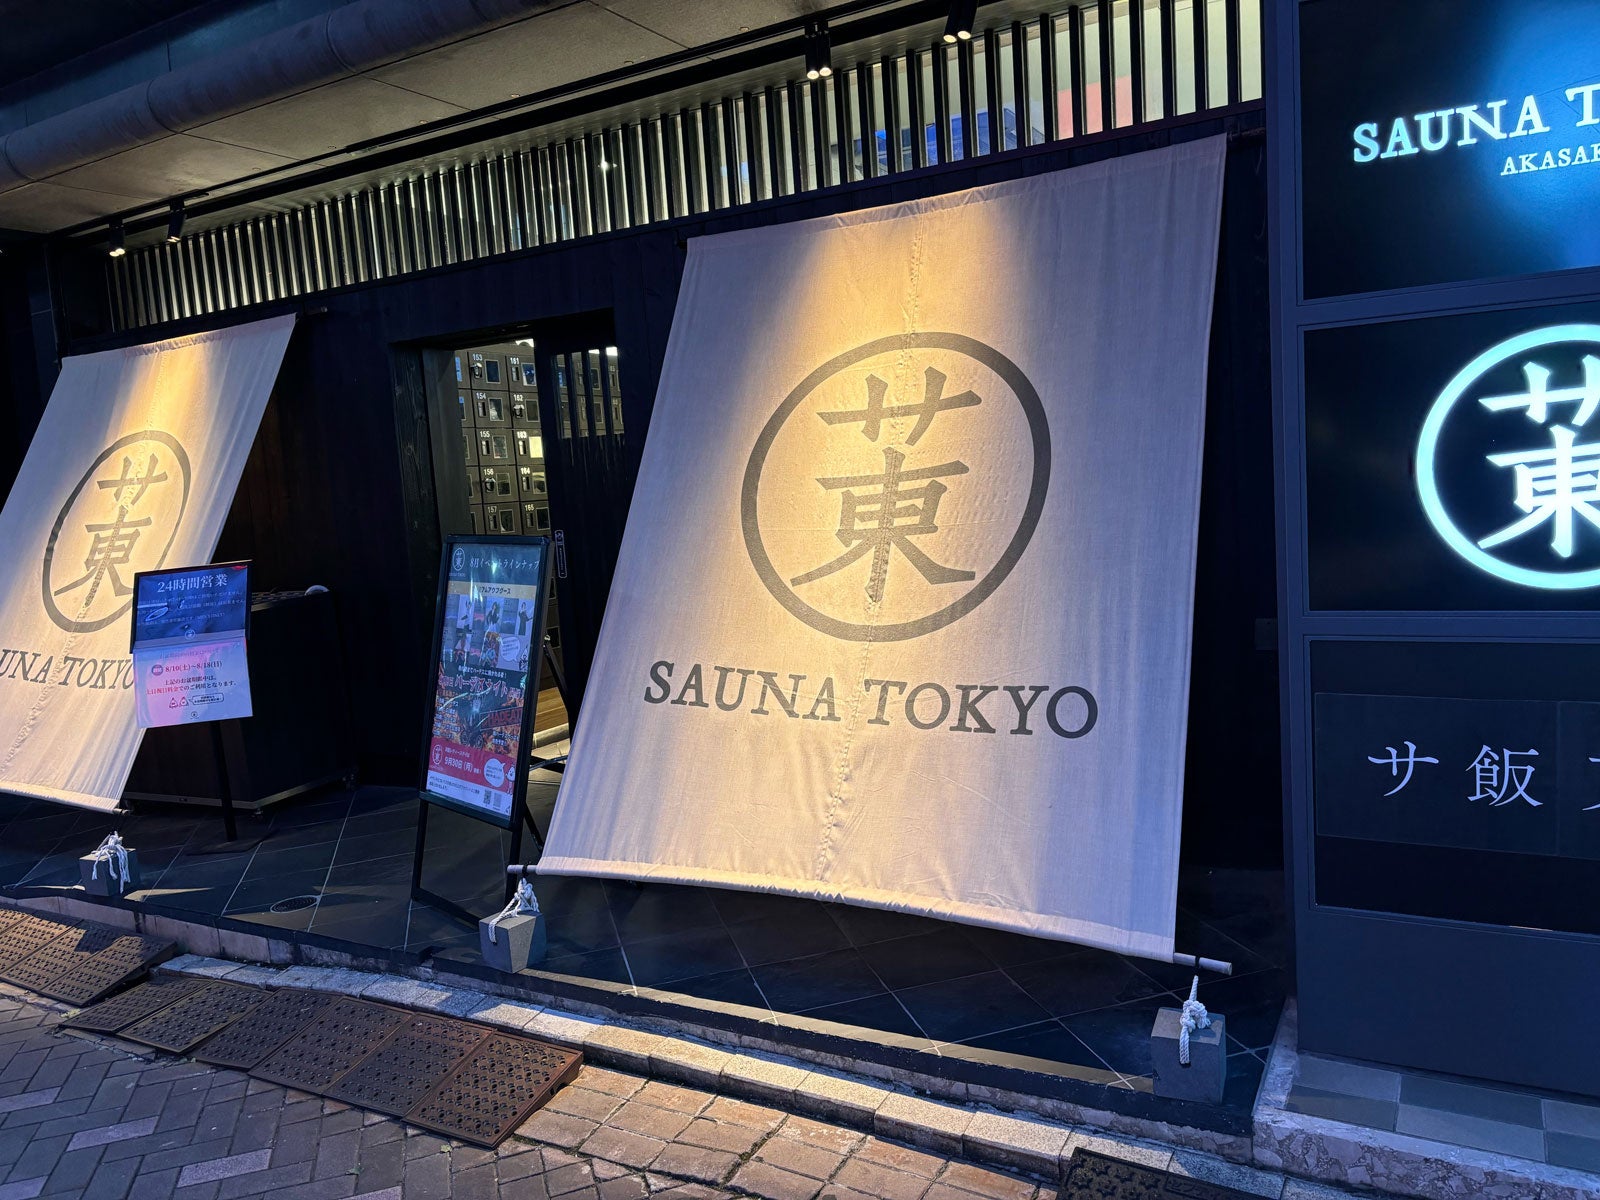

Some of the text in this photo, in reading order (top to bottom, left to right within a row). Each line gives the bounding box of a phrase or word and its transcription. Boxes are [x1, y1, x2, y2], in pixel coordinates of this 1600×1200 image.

[1353, 95, 1550, 163] SAUNA
[157, 574, 228, 593] 24時間営業
[643, 661, 1099, 739] SAUNA TOKYO
